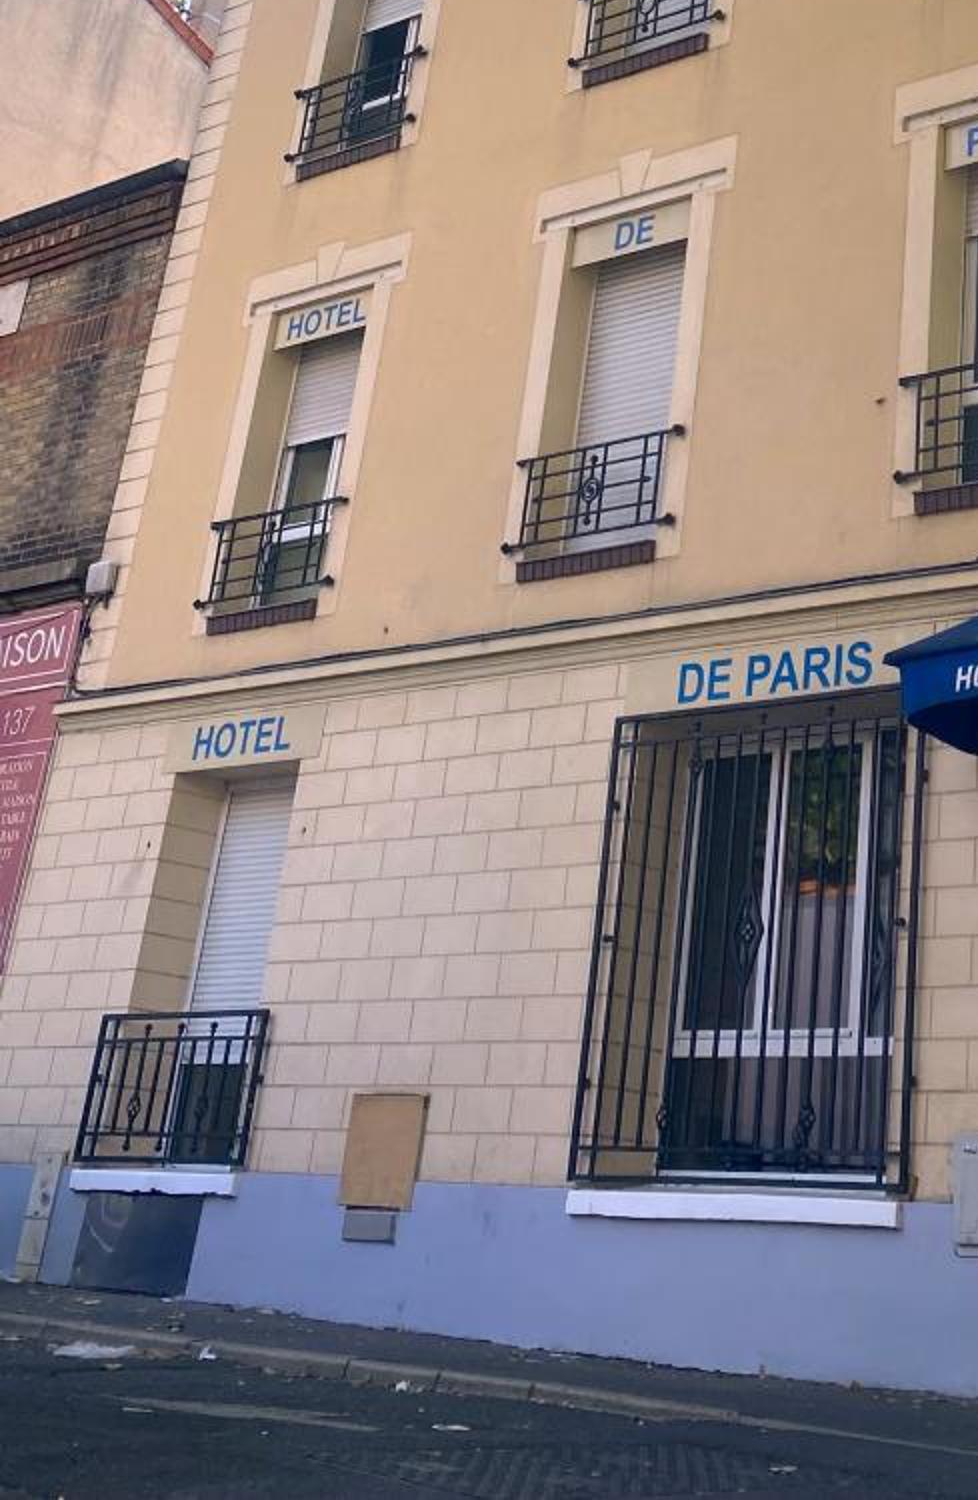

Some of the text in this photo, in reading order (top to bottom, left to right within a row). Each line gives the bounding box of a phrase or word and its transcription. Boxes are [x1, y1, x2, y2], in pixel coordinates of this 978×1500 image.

[613, 214, 656, 251] DE
[286, 299, 367, 340] HOTEL
[677, 640, 874, 704] DE PARIS
[191, 715, 290, 761] HOTEL
